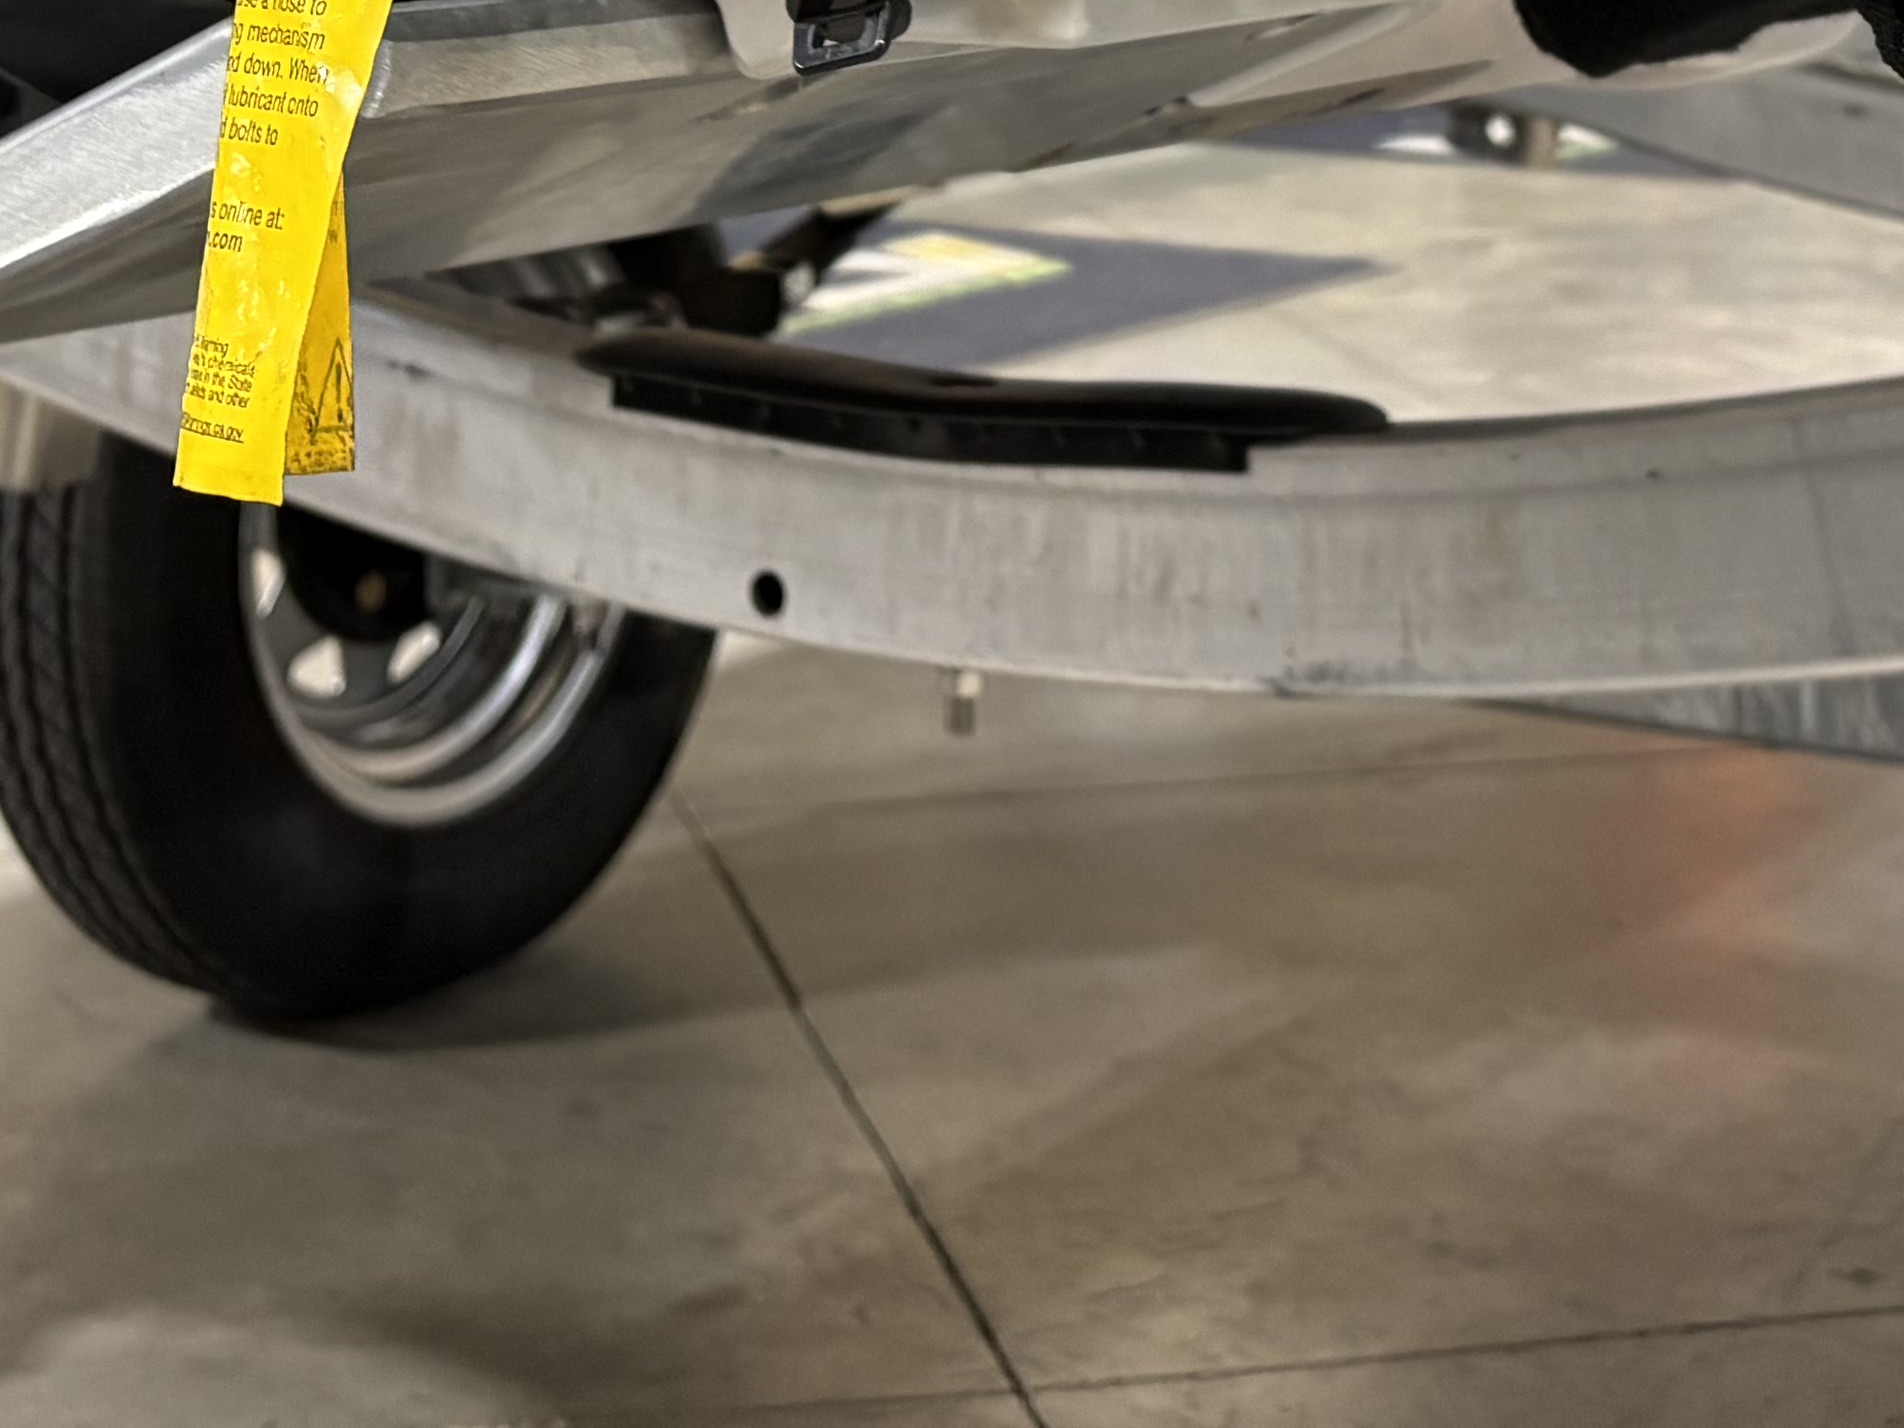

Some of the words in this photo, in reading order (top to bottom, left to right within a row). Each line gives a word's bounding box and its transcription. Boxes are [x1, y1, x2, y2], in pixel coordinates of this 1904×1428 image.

[247, 23, 326, 51] mechanism
[244, 52, 283, 79] down.
[289, 56, 329, 85] When
[228, 83, 288, 114] lubricant
[287, 94, 319, 118] onto
[228, 116, 263, 143] bolts
[265, 124, 279, 146] to
